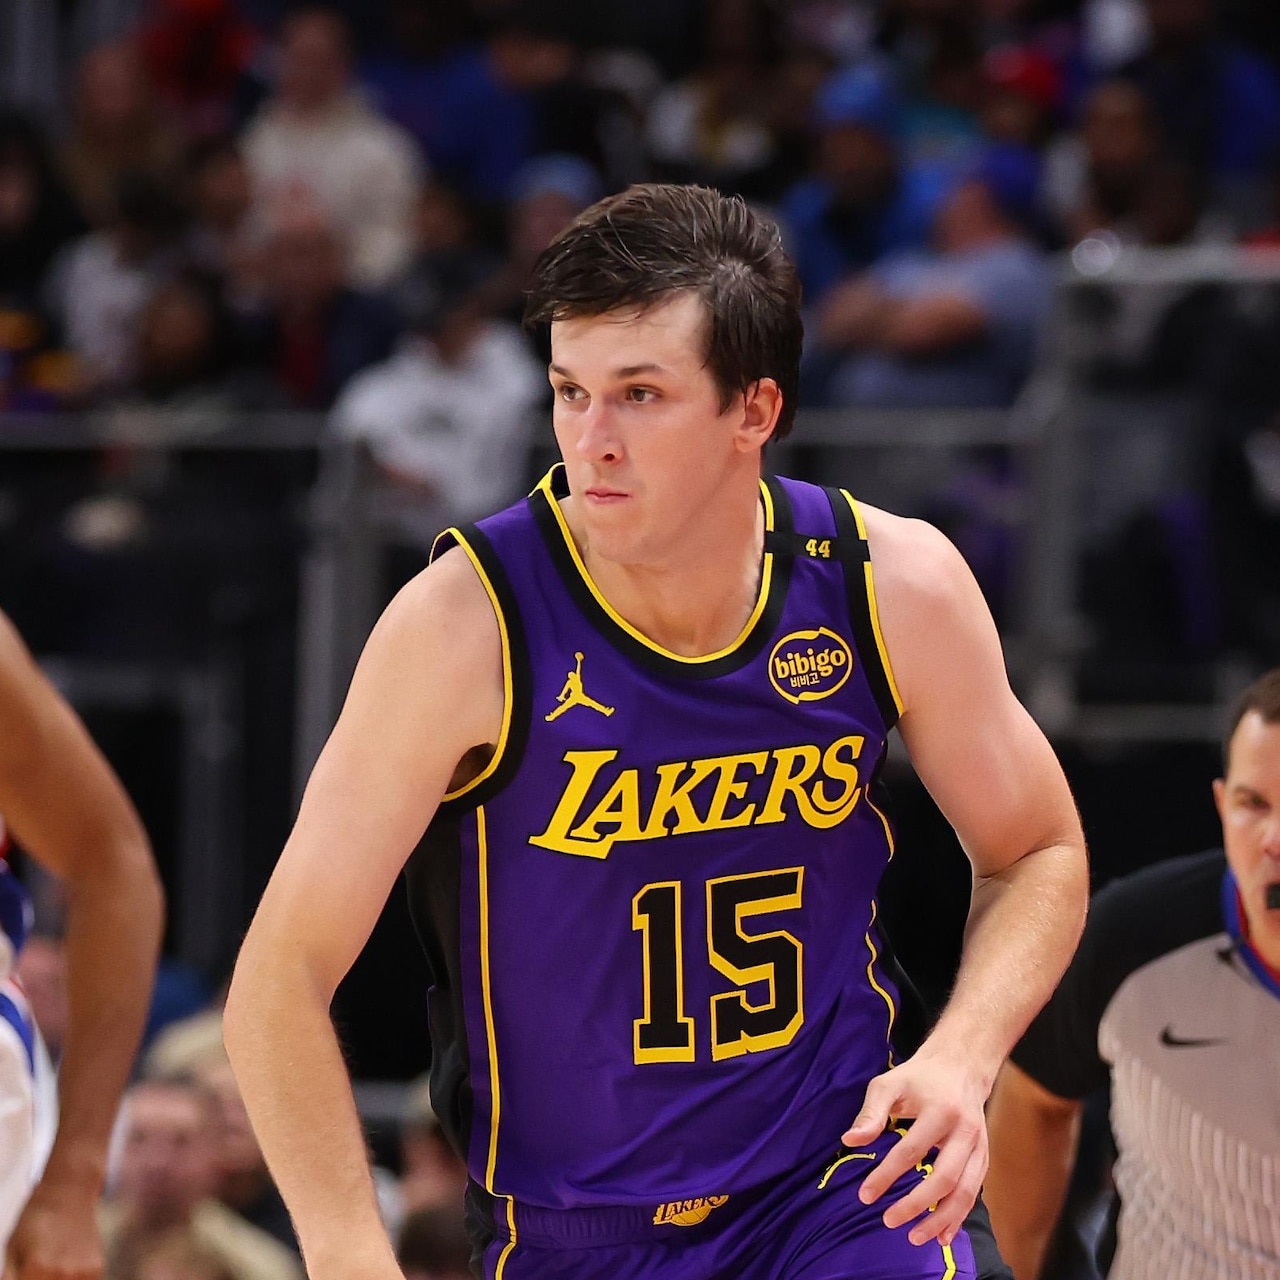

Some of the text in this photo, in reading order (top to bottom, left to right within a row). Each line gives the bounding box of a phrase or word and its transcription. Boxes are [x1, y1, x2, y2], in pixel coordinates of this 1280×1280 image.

[806, 538, 832, 559] 44
[774, 648, 847, 679] bibigo
[790, 672, 820, 688] 비비고
[528, 735, 865, 860] LAKERS
[631, 866, 805, 1066] 15
